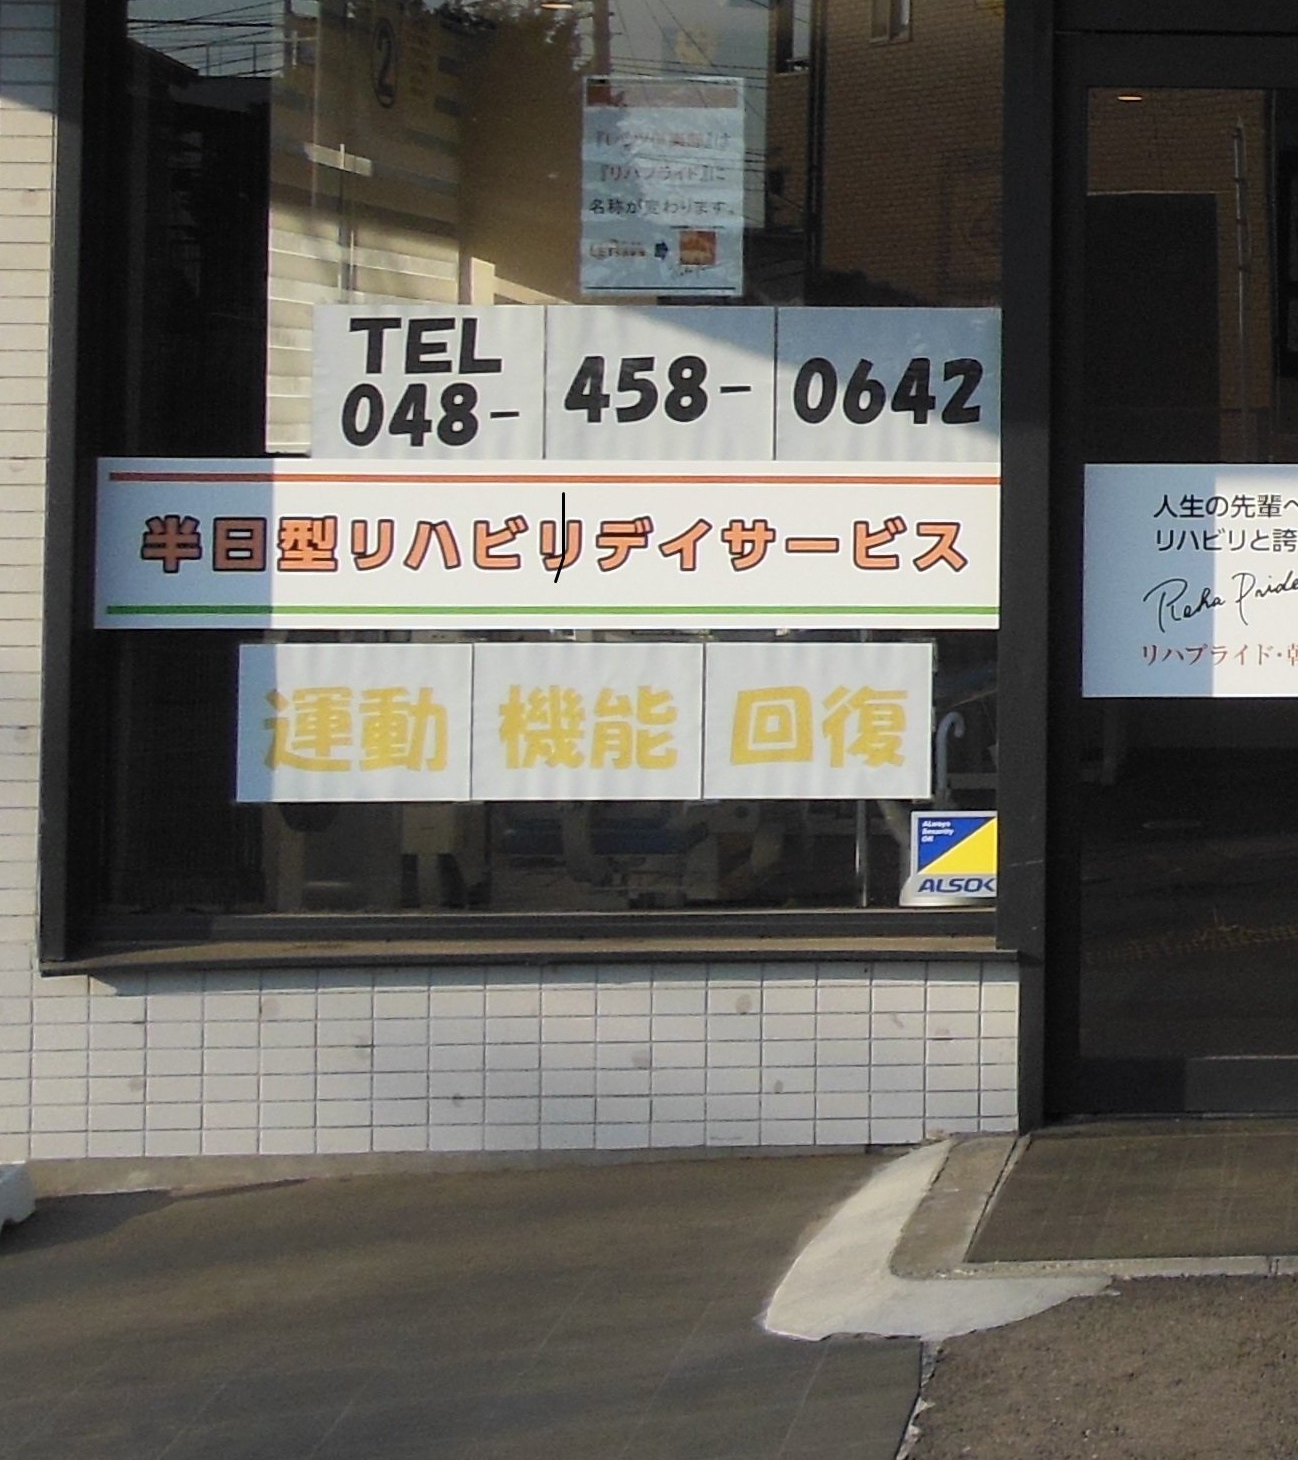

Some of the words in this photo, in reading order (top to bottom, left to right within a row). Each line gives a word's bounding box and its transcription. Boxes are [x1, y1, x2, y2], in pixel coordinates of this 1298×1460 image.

[349, 316, 503, 375] TEL
[341, 382, 521, 448] 048-
[564, 354, 753, 425] 458-
[792, 357, 986, 426] 0642
[140, 513, 969, 576] 半日型リハビリデイサービス
[918, 877, 996, 893] ALSOK
